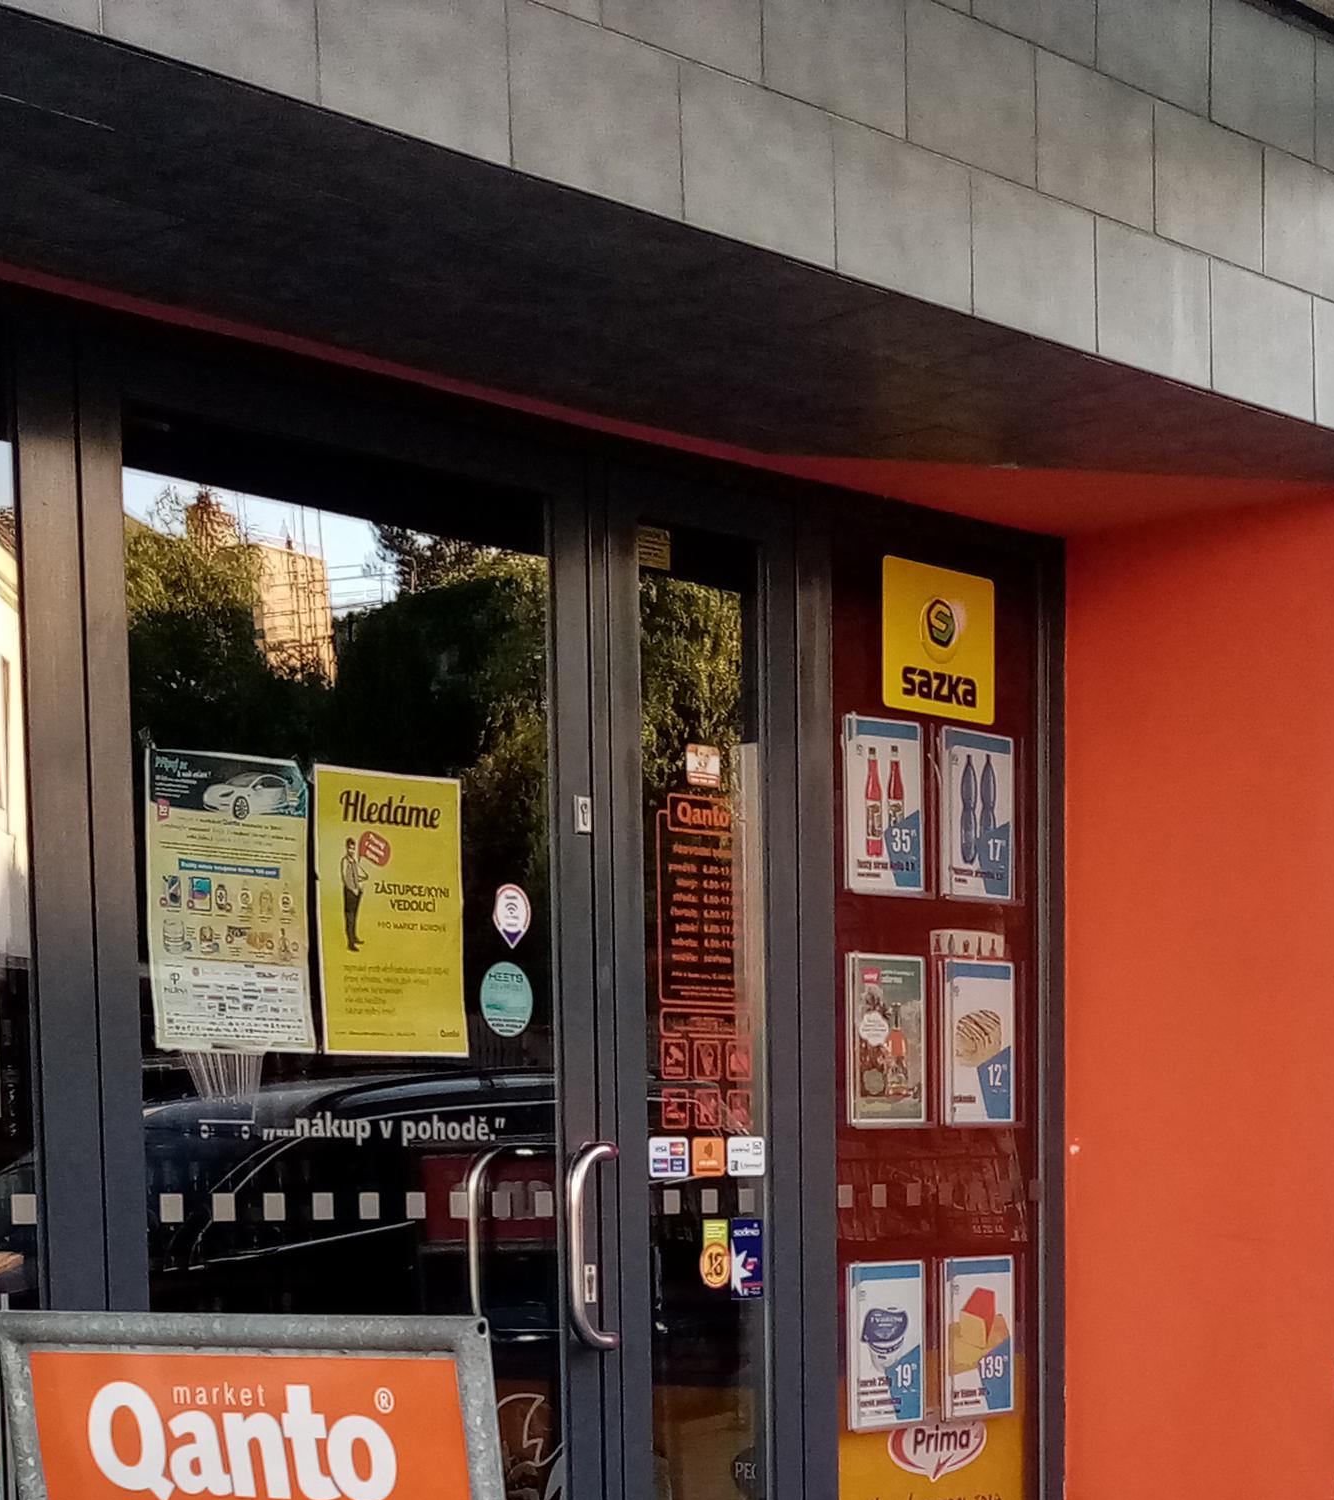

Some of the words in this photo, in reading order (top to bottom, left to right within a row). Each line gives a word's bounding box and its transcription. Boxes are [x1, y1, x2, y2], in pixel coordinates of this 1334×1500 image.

[339, 789, 441, 829] Hledáme
[676, 801, 731, 828] Qanto
[390, 897, 436, 913] VEDOUCÍ
[381, 1121, 394, 1139] v
[172, 1381, 266, 1407] market
[913, 1424, 971, 1456] Prima
